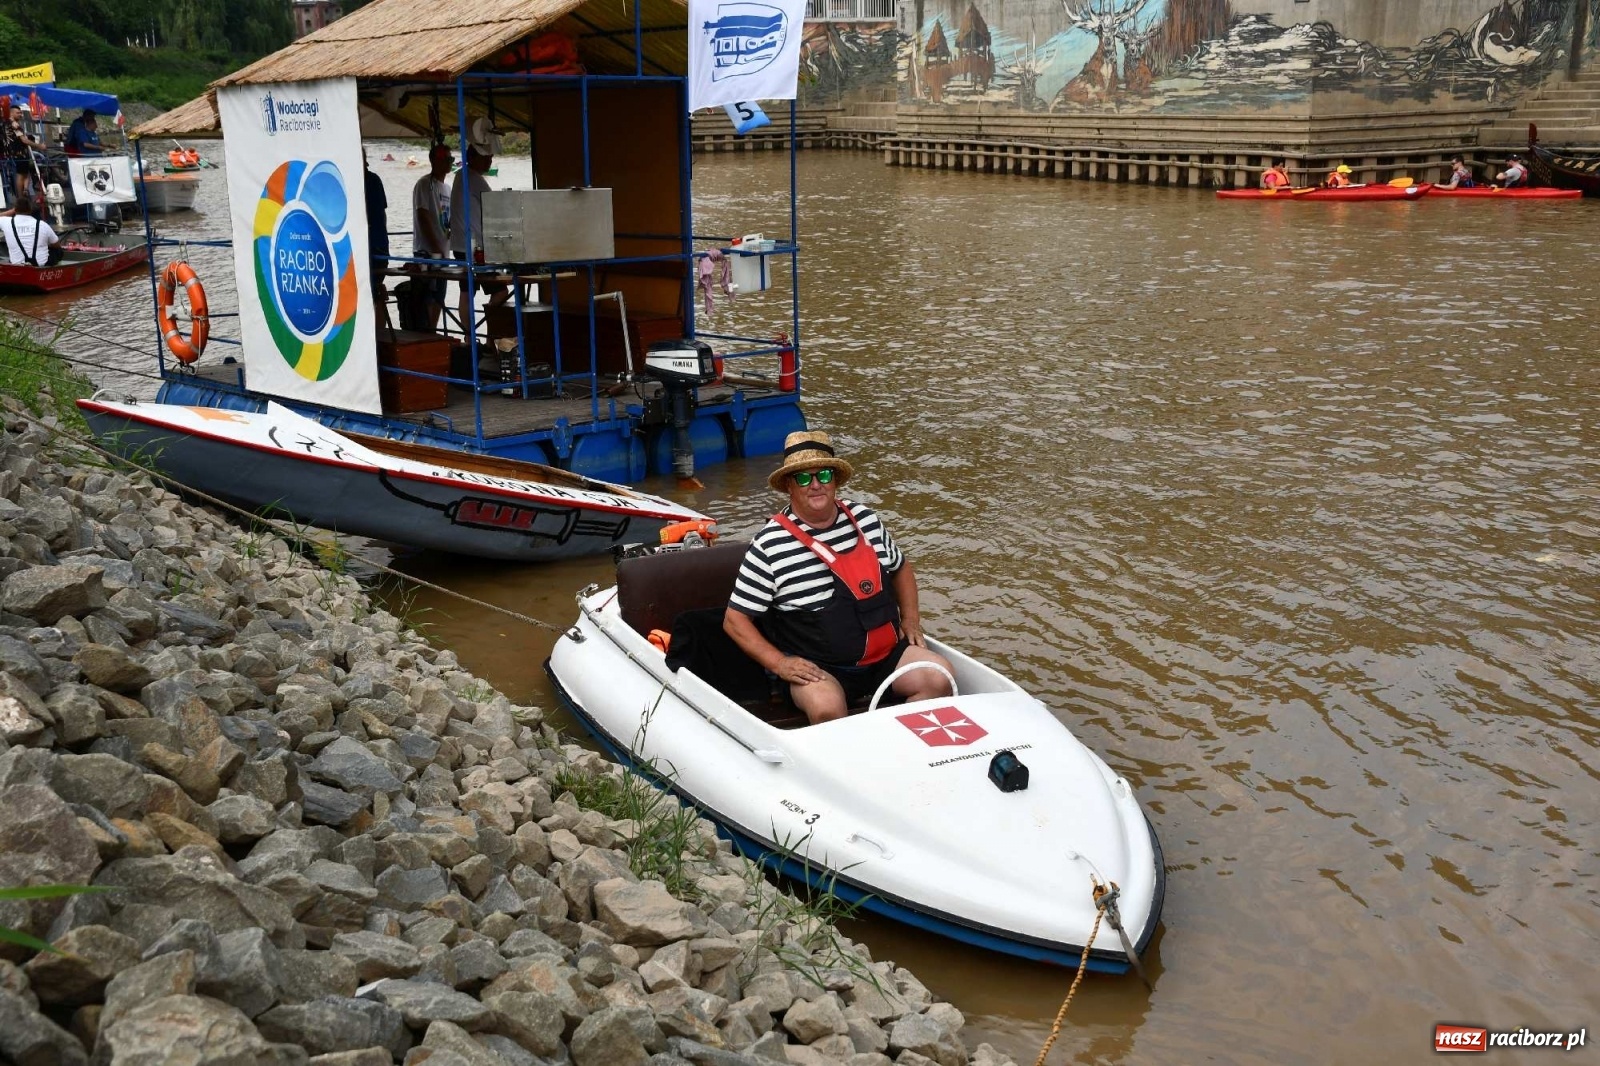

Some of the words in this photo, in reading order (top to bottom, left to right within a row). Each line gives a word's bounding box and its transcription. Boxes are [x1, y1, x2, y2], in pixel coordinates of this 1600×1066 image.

[11, 69, 44, 80] POLACY
[277, 98, 319, 116] Wodociągi
[735, 101, 755, 121] 5
[279, 118, 321, 131] Raciborskie
[279, 249, 326, 273] RACIBO
[281, 273, 330, 297] RZANKA
[672, 360, 693, 369] YAMAHA
[804, 813, 821, 825] 3
